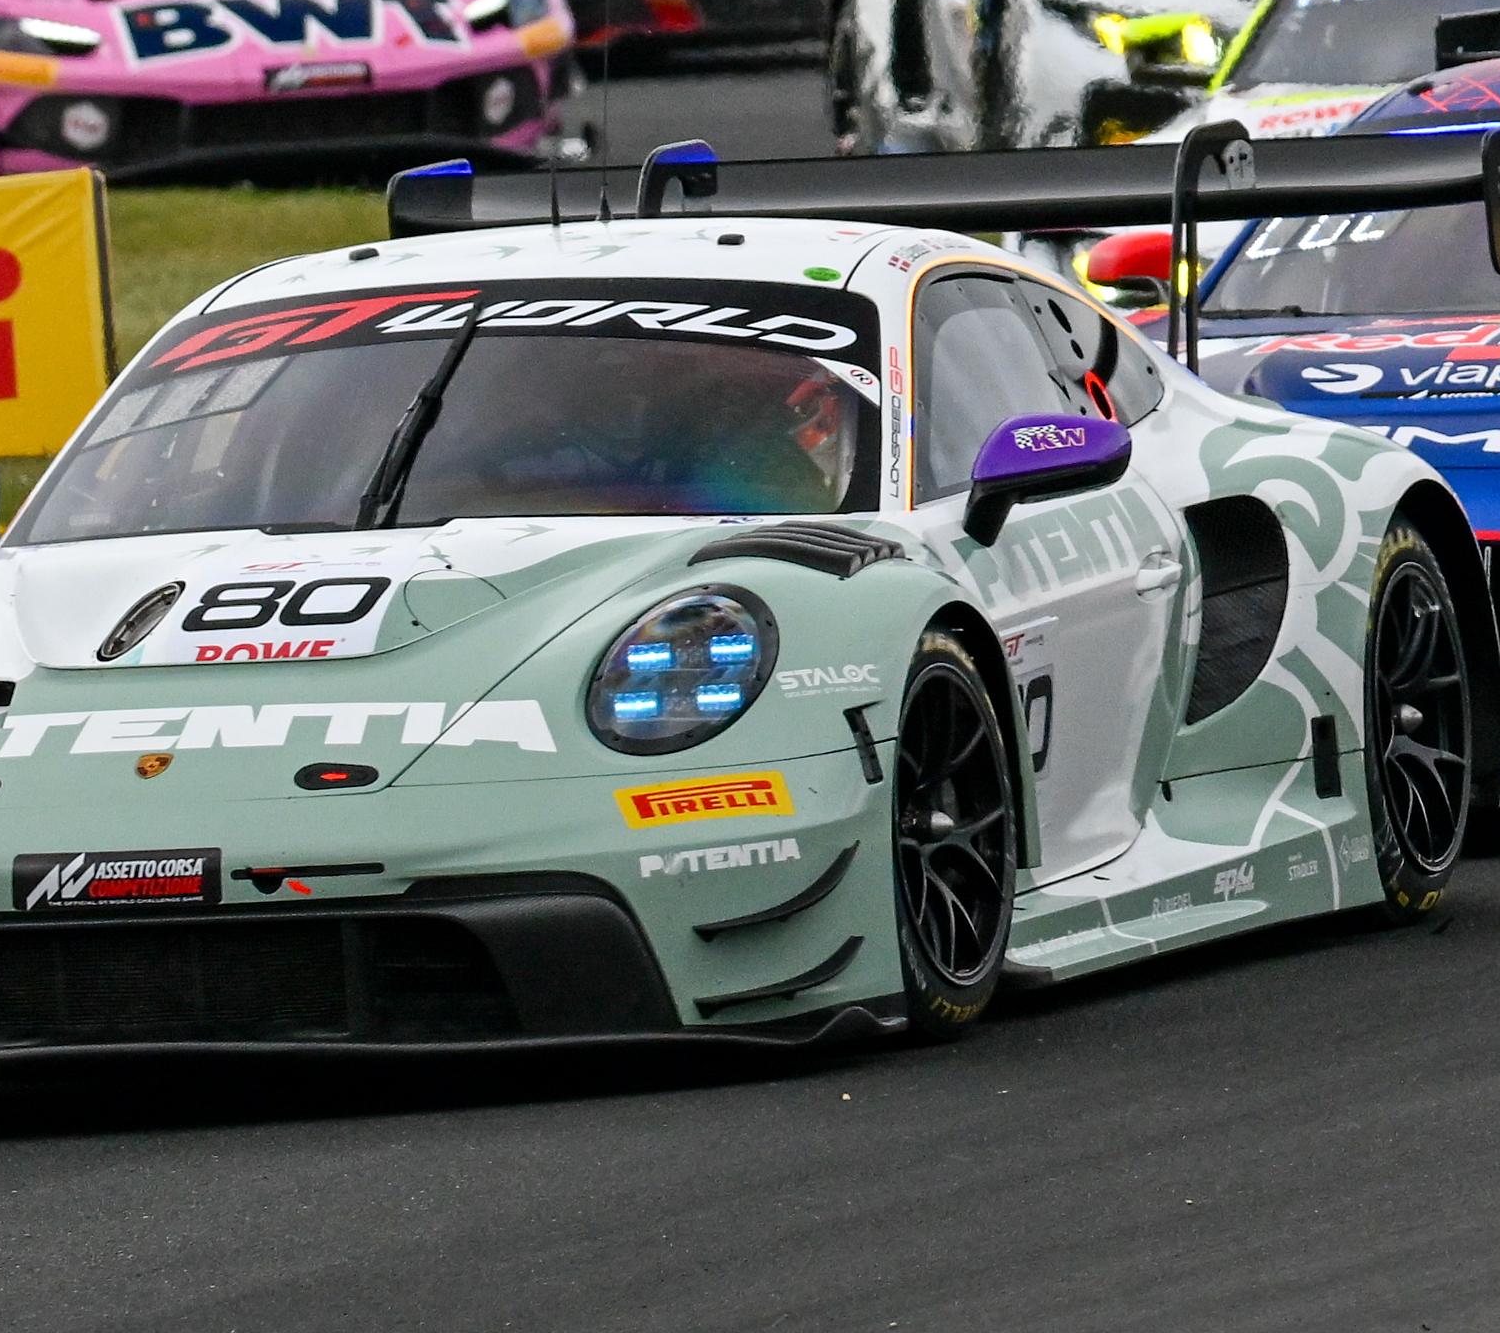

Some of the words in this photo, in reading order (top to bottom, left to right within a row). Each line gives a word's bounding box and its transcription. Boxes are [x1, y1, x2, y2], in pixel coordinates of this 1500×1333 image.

[150, 289, 482, 371] GT
[376, 299, 857, 352] WORLD
[889, 346, 903, 396] GP
[889, 395, 901, 499] LIONSPEED
[1032, 428, 1086, 452] KW
[182, 576, 392, 633] 80
[195, 639, 336, 663] ROWE
[775, 663, 881, 691] STALOC
[1019, 673, 1054, 774] 0
[633, 779, 779, 821] PIRELLI
[89, 876, 203, 898] COMPETIZIONE
[94, 860, 158, 880] ASSETTO
[157, 858, 204, 877] CORSA
